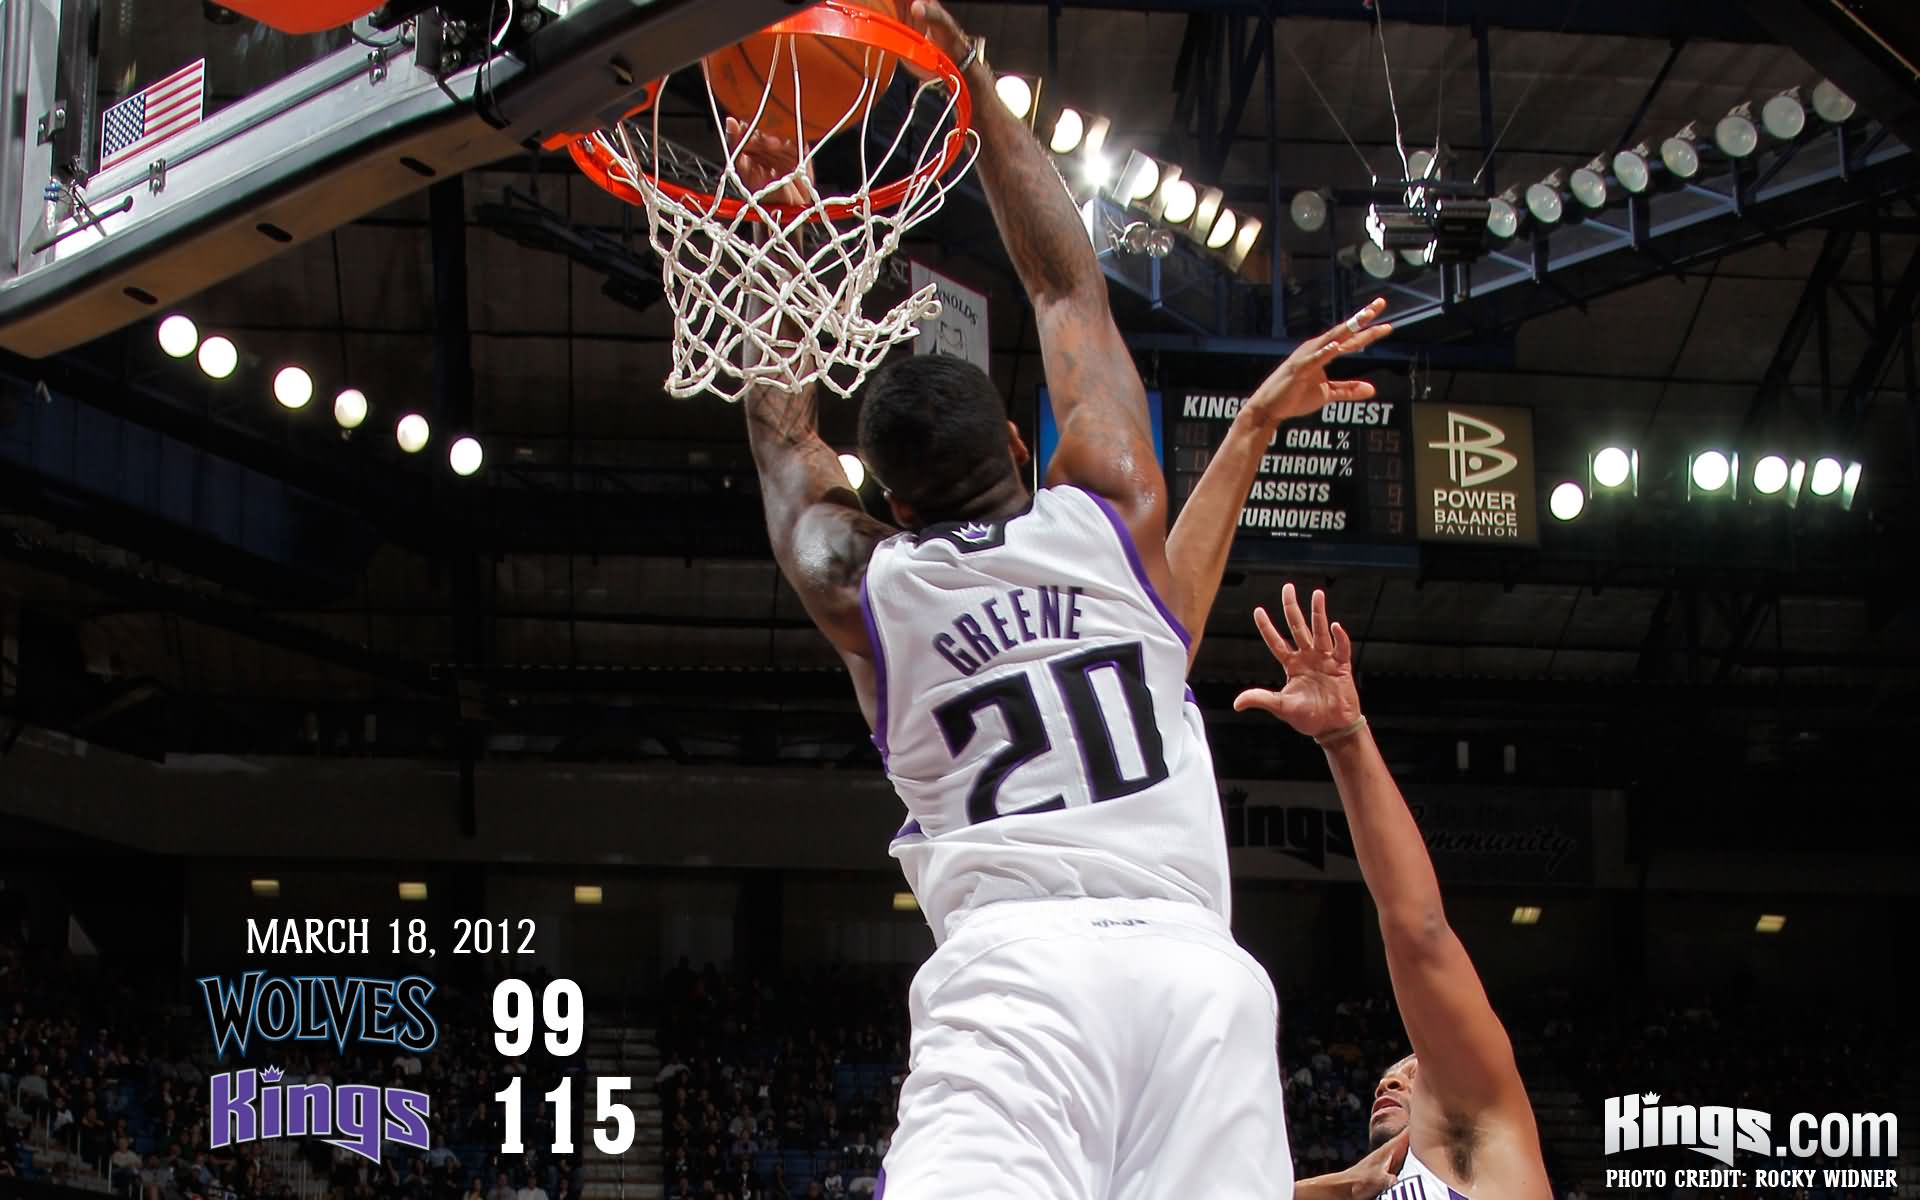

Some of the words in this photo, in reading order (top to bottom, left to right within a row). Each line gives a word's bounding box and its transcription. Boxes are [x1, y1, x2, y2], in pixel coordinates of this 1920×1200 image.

[1321, 402, 1394, 425] GUEST
[1286, 429, 1332, 449] GOAL
[1249, 481, 1330, 502] ASSISTS
[1434, 489, 1516, 510] POWER
[1238, 507, 1346, 530] TURNOVERS
[1434, 508, 1517, 527] BALANCE
[1434, 524, 1518, 537] PAVILION
[932, 585, 1084, 676] GREENE
[932, 640, 1170, 825] 20
[1227, 787, 1353, 872] ings
